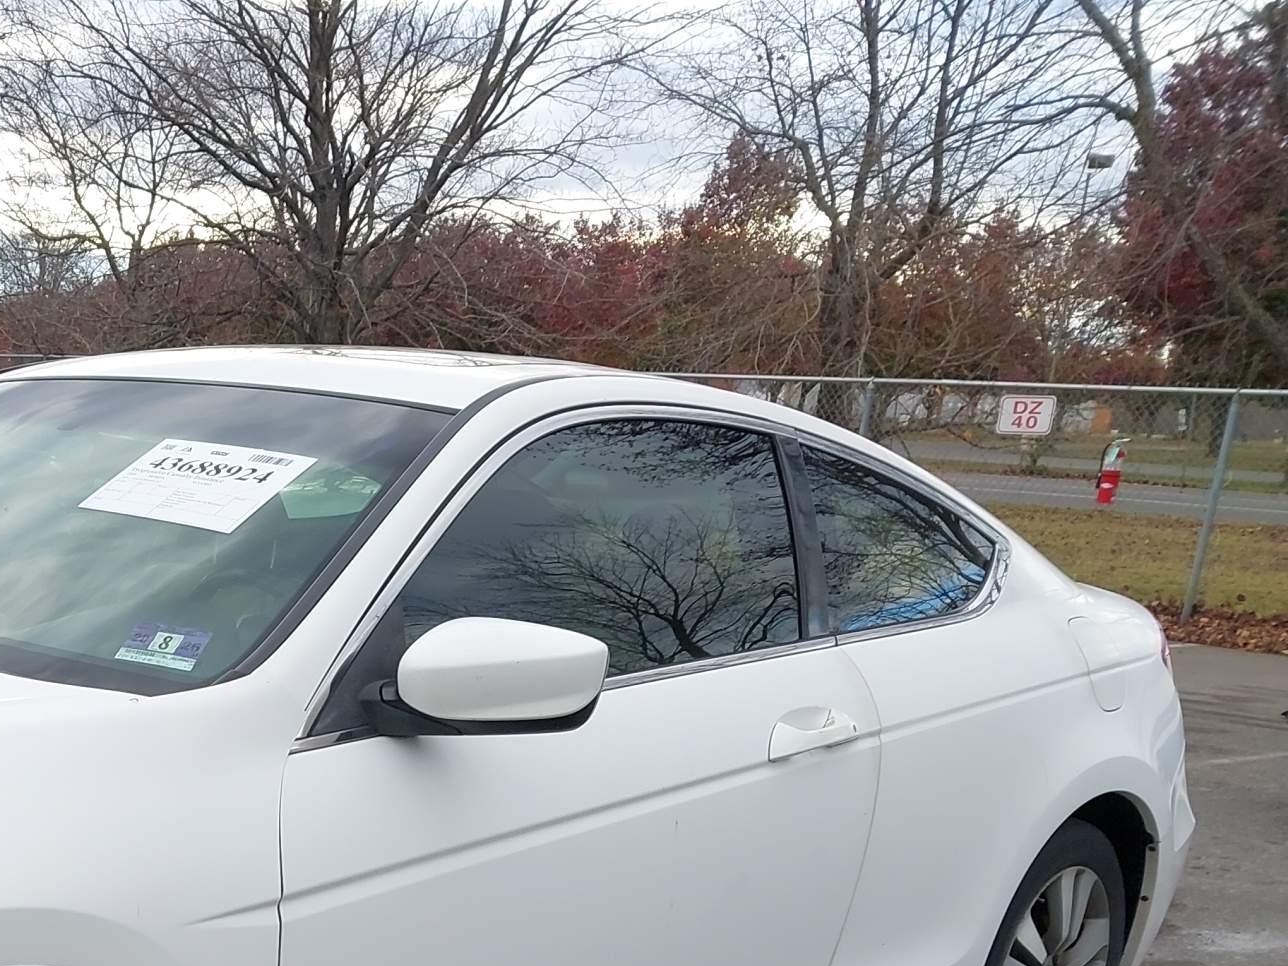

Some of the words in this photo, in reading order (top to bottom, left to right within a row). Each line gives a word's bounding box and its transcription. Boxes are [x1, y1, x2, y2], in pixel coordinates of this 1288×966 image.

[1013, 400, 1043, 415] DZ
[1011, 415, 1038, 429] 40
[150, 456, 274, 483] 43688924
[158, 635, 174, 650] 8
